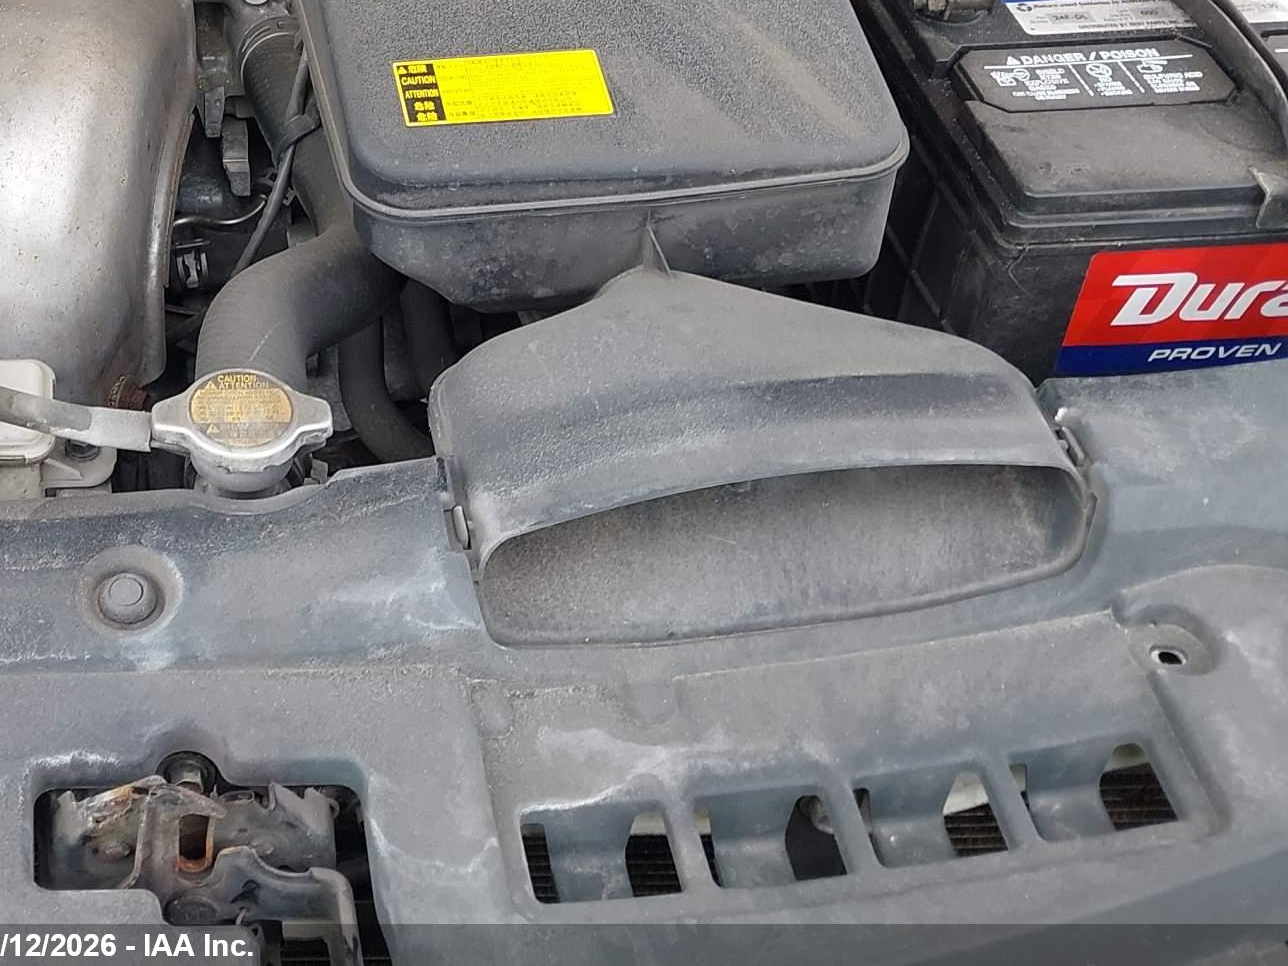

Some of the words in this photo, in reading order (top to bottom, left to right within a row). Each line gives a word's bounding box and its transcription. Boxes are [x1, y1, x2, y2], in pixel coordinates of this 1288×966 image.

[1020, 52, 1087, 65] DANGER
[1102, 48, 1161, 60] POISON
[401, 74, 436, 86] CAUTION
[405, 88, 440, 99] ATTENTION
[1148, 342, 1282, 362] PROVEN
[217, 374, 257, 383] CAUTION
[219, 380, 269, 390] ATTENTION
